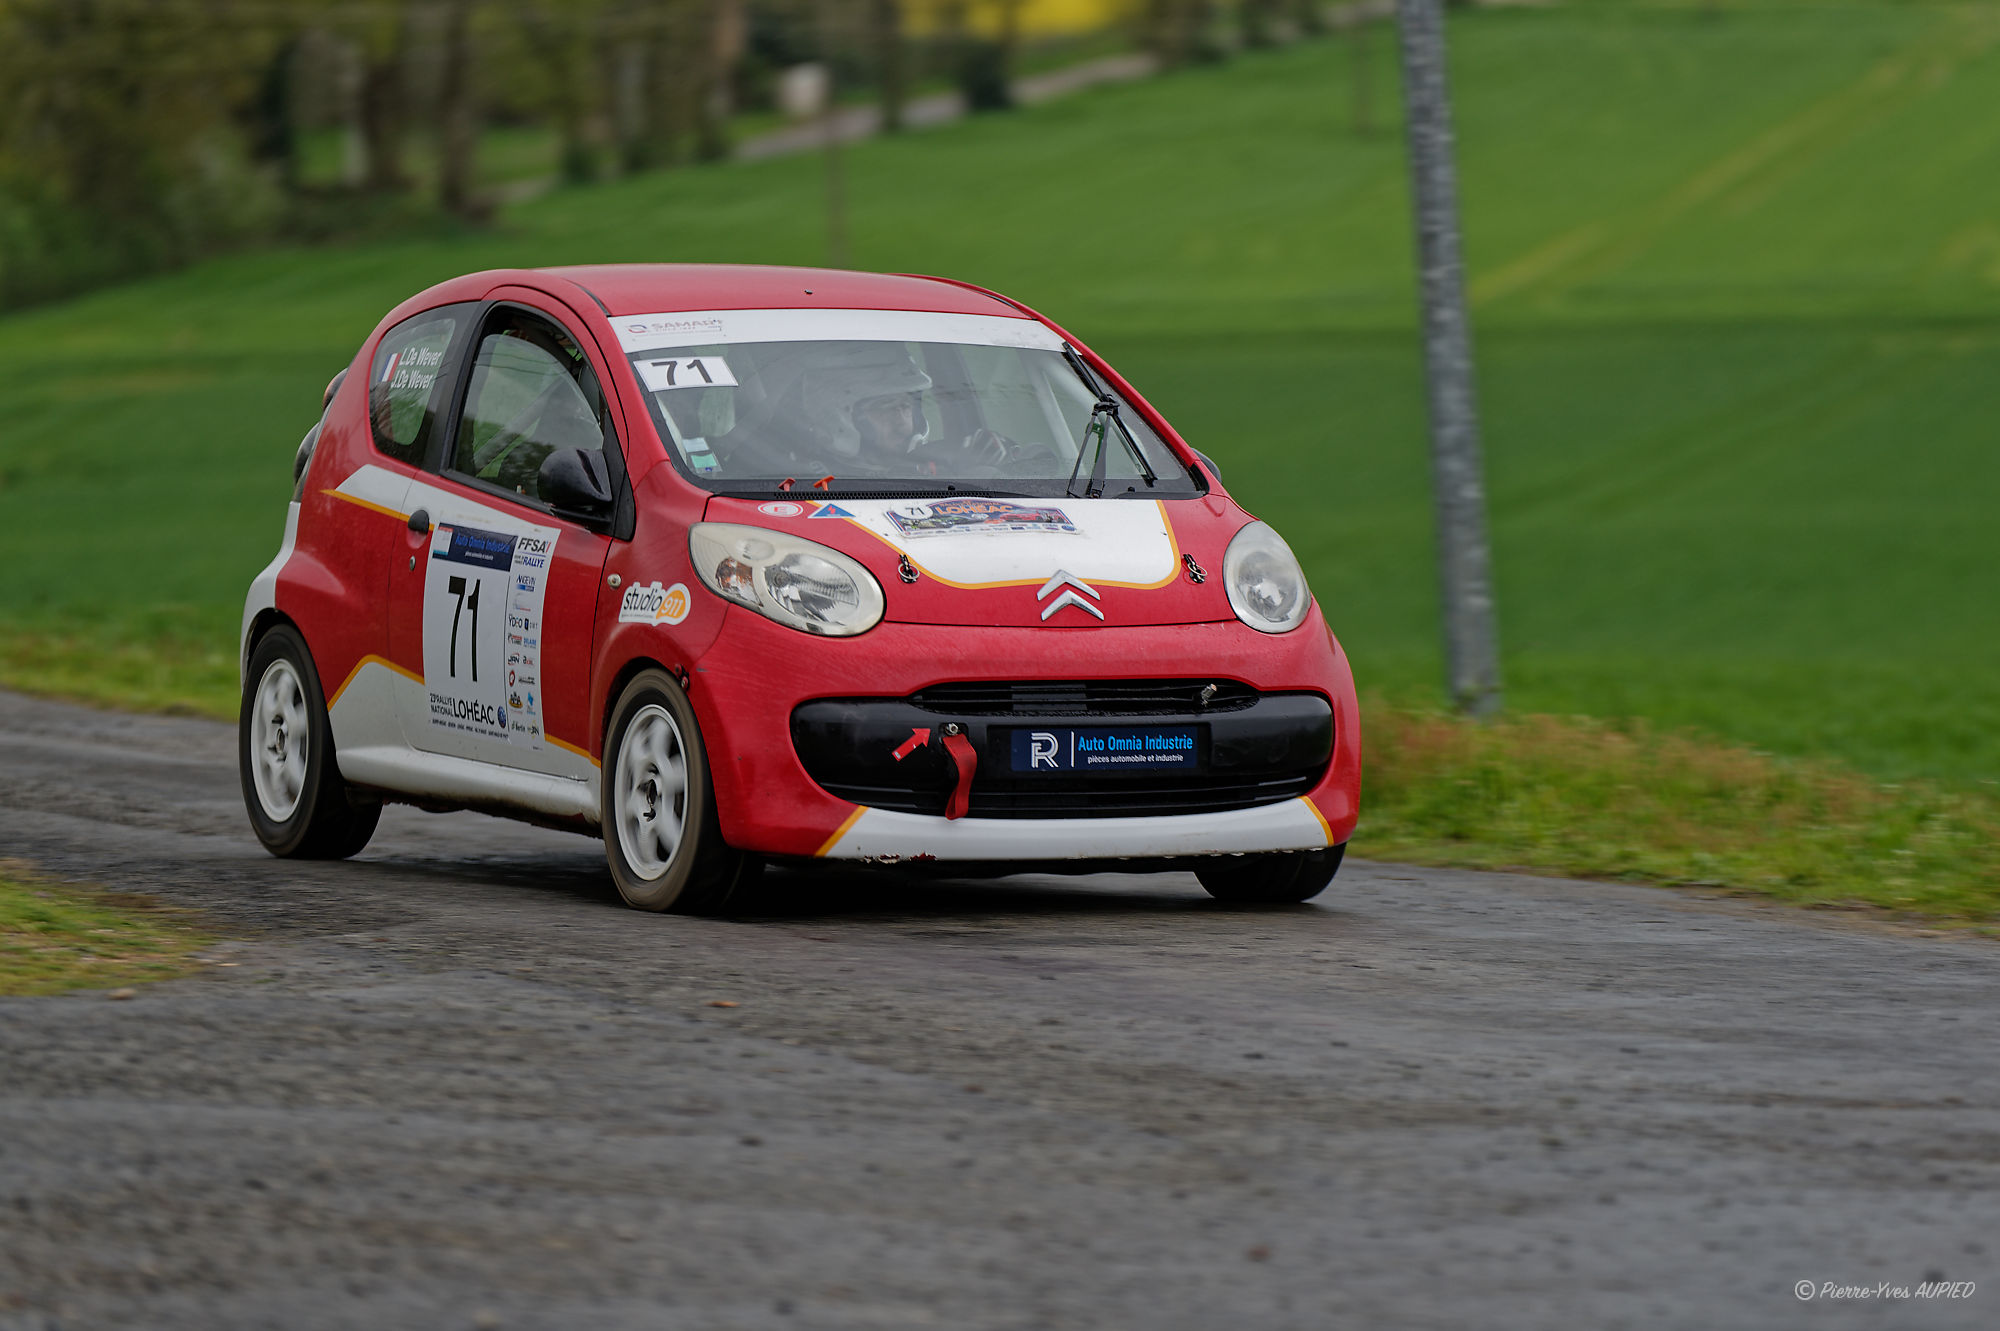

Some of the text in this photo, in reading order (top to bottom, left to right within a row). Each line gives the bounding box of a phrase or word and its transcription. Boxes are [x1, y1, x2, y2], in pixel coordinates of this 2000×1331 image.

[400, 347, 442, 366] L.De Wever
[390, 369, 433, 389] J.De Wever
[650, 359, 713, 386] 71
[904, 507, 925, 516] 71
[455, 533, 468, 547] Auto
[468, 536, 485, 550] Omnia
[518, 537, 546, 553] FFSA
[523, 556, 545, 568] RALLYE
[623, 588, 684, 616] studio 911
[448, 575, 480, 682] 71
[430, 705, 453, 717] NATIONAL
[453, 698, 494, 725] LOHÉAC
[1078, 734, 1193, 751] Auto Omnia Industrie
[1087, 754, 1184, 764] pièces automobile et industrie
